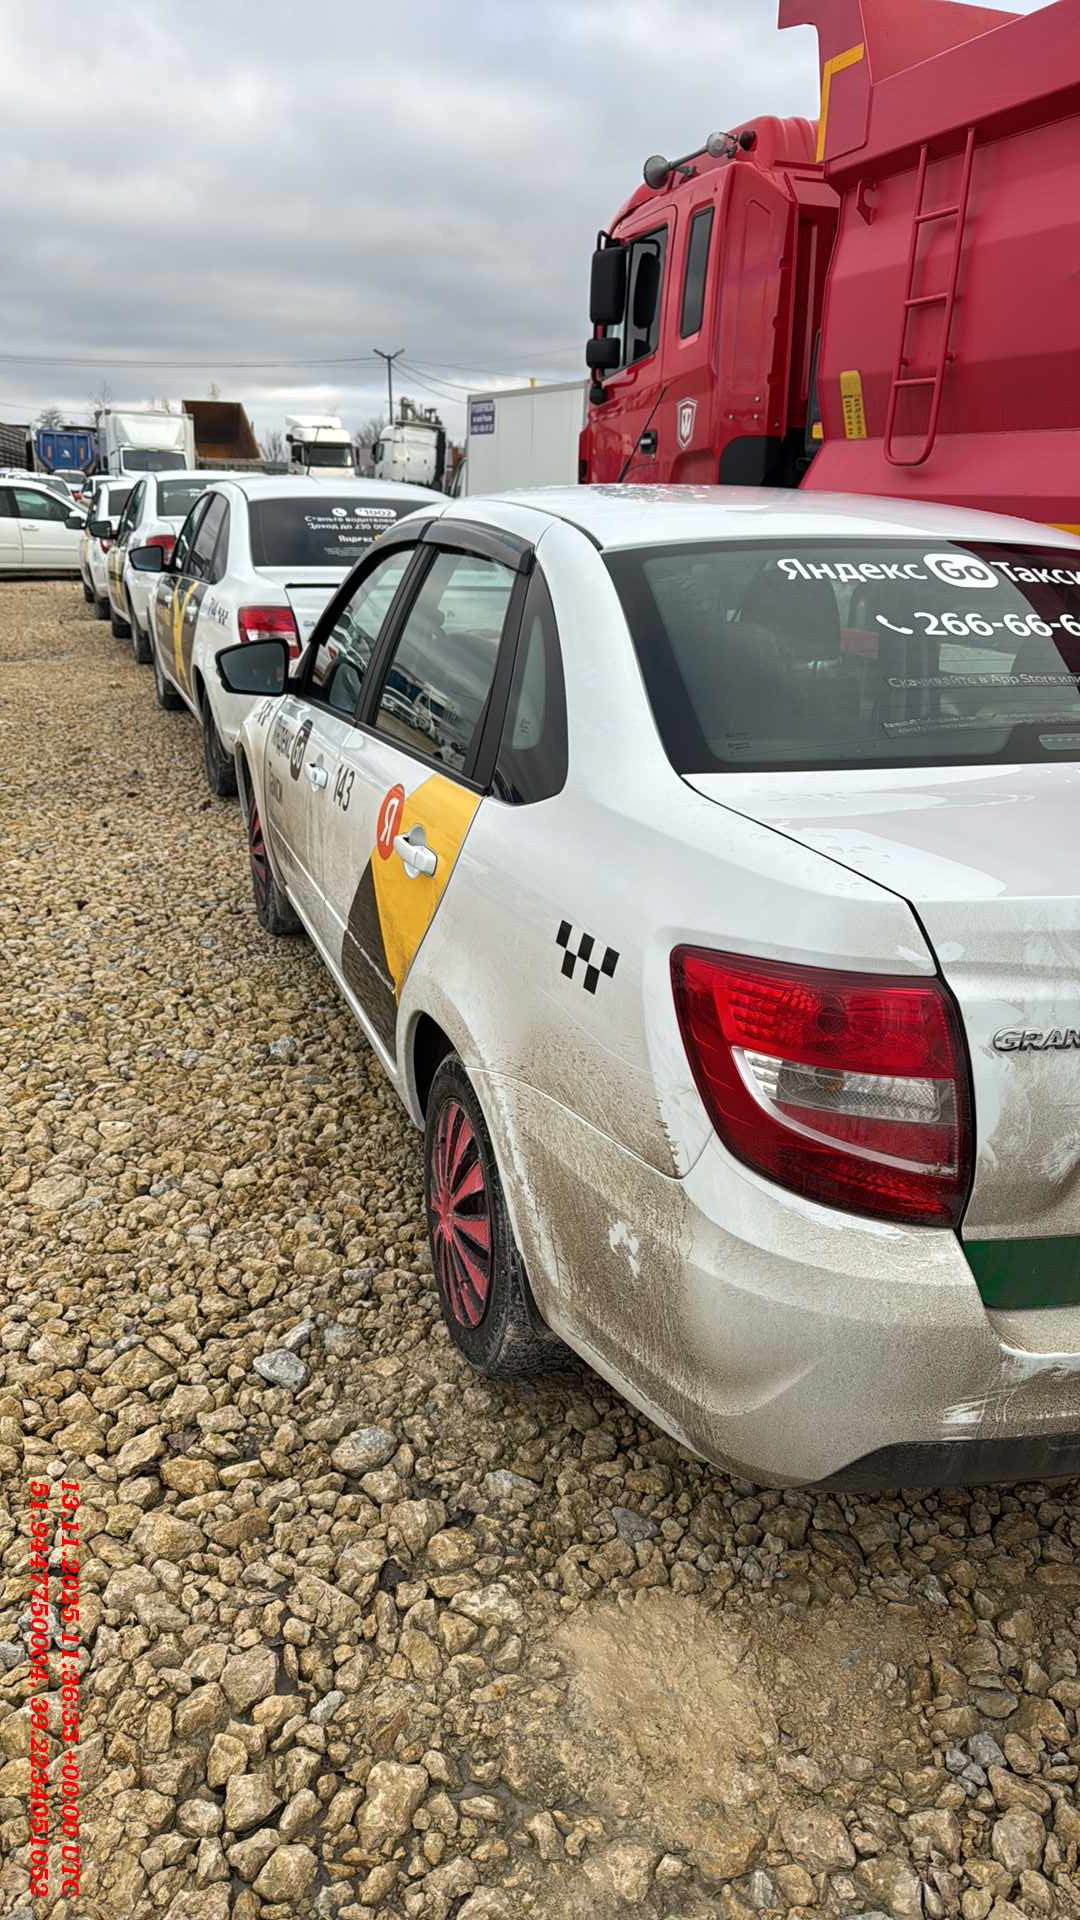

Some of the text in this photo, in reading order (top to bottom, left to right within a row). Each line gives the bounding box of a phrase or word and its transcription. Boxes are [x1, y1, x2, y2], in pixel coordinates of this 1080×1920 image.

[777, 558, 929, 583] Яндекс
[990, 561, 1080, 585] Такси
[990, 674, 1020, 686] App
[1020, 673, 1058, 684] Store
[333, 764, 355, 812] 143
